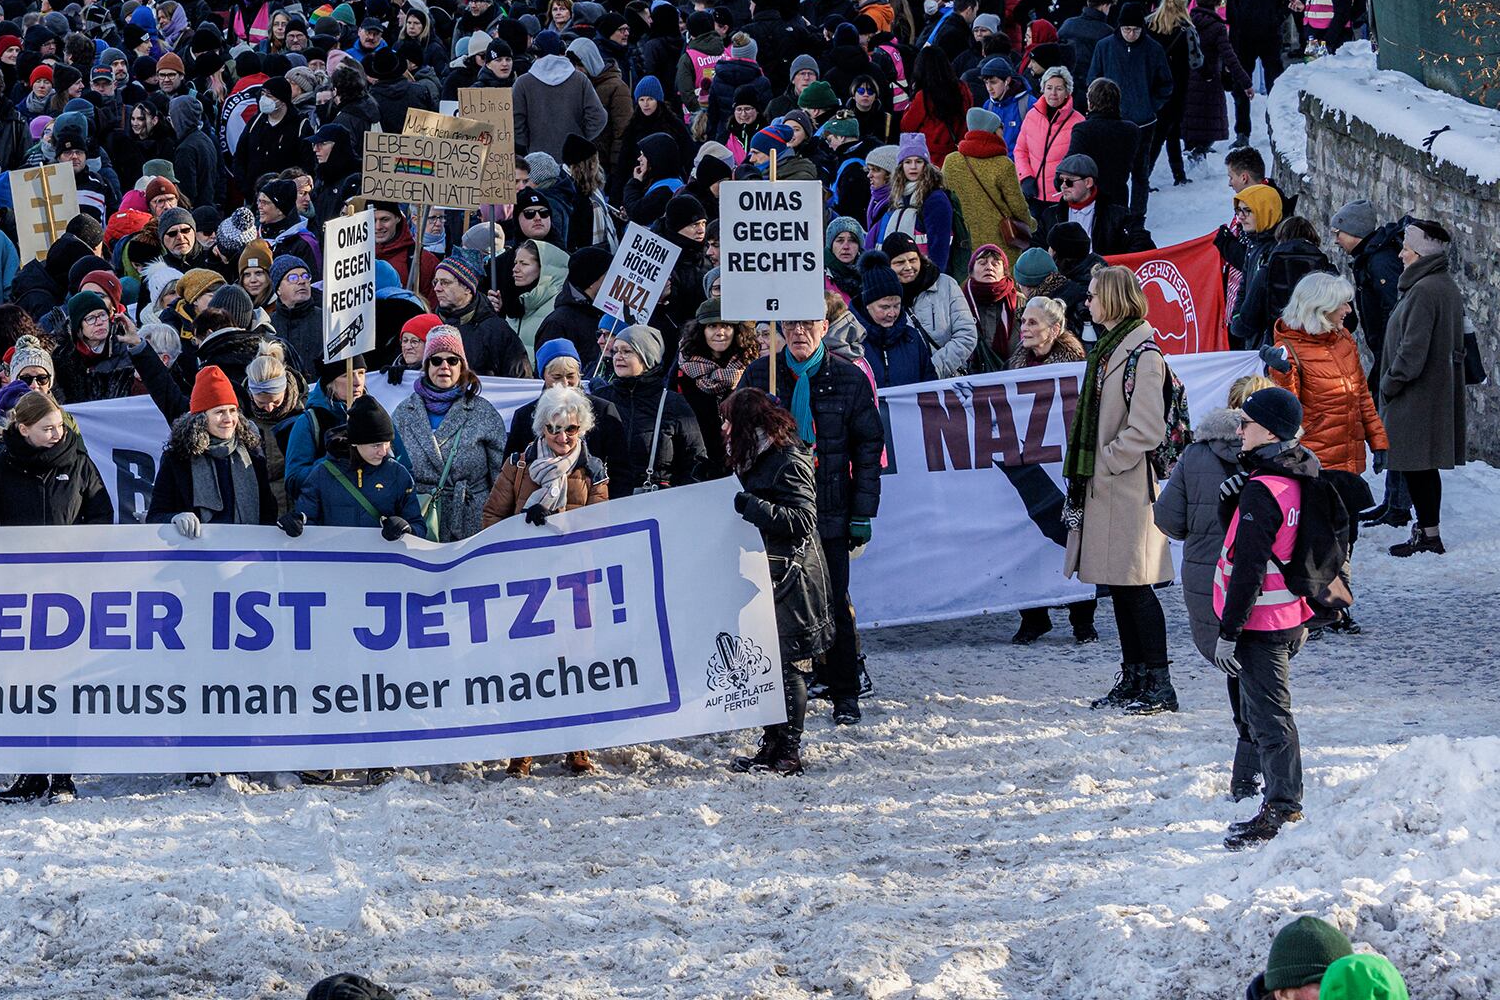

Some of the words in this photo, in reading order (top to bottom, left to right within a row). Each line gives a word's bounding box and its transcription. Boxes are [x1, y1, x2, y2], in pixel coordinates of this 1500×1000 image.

[222, 90, 252, 119] music
[220, 123, 229, 154] love
[364, 133, 409, 156] LEBE
[412, 140, 438, 161] SO,
[438, 142, 481, 165] DASS
[362, 153, 392, 174] DIE
[393, 157, 435, 178] AFD
[436, 161, 480, 182] ETWAS
[361, 175, 435, 202] DAGEGEN
[438, 180, 481, 205] HÄTTE
[739, 190, 802, 211] OMAS
[336, 223, 369, 249] OMAS
[732, 219, 809, 241] GEGEN
[630, 234, 669, 265] BJÖRN
[728, 250, 816, 272] RECHTS
[333, 256, 371, 282] GEGEN
[622, 252, 661, 283] HÖCKE
[628, 271, 637, 280] IST
[636, 275, 645, 284] EIN
[330, 285, 375, 313] RECHTS
[210, 590, 327, 652] IST
[352, 564, 626, 652] JETZT!
[69, 680, 188, 715] muss
[200, 680, 296, 714] man
[310, 667, 451, 714] selber
[464, 656, 640, 706] machen
[705, 696, 723, 709] AUF
[724, 692, 740, 702] DIE
[741, 681, 776, 699] PLÄTZE,
[723, 695, 760, 713] FERTIG!
